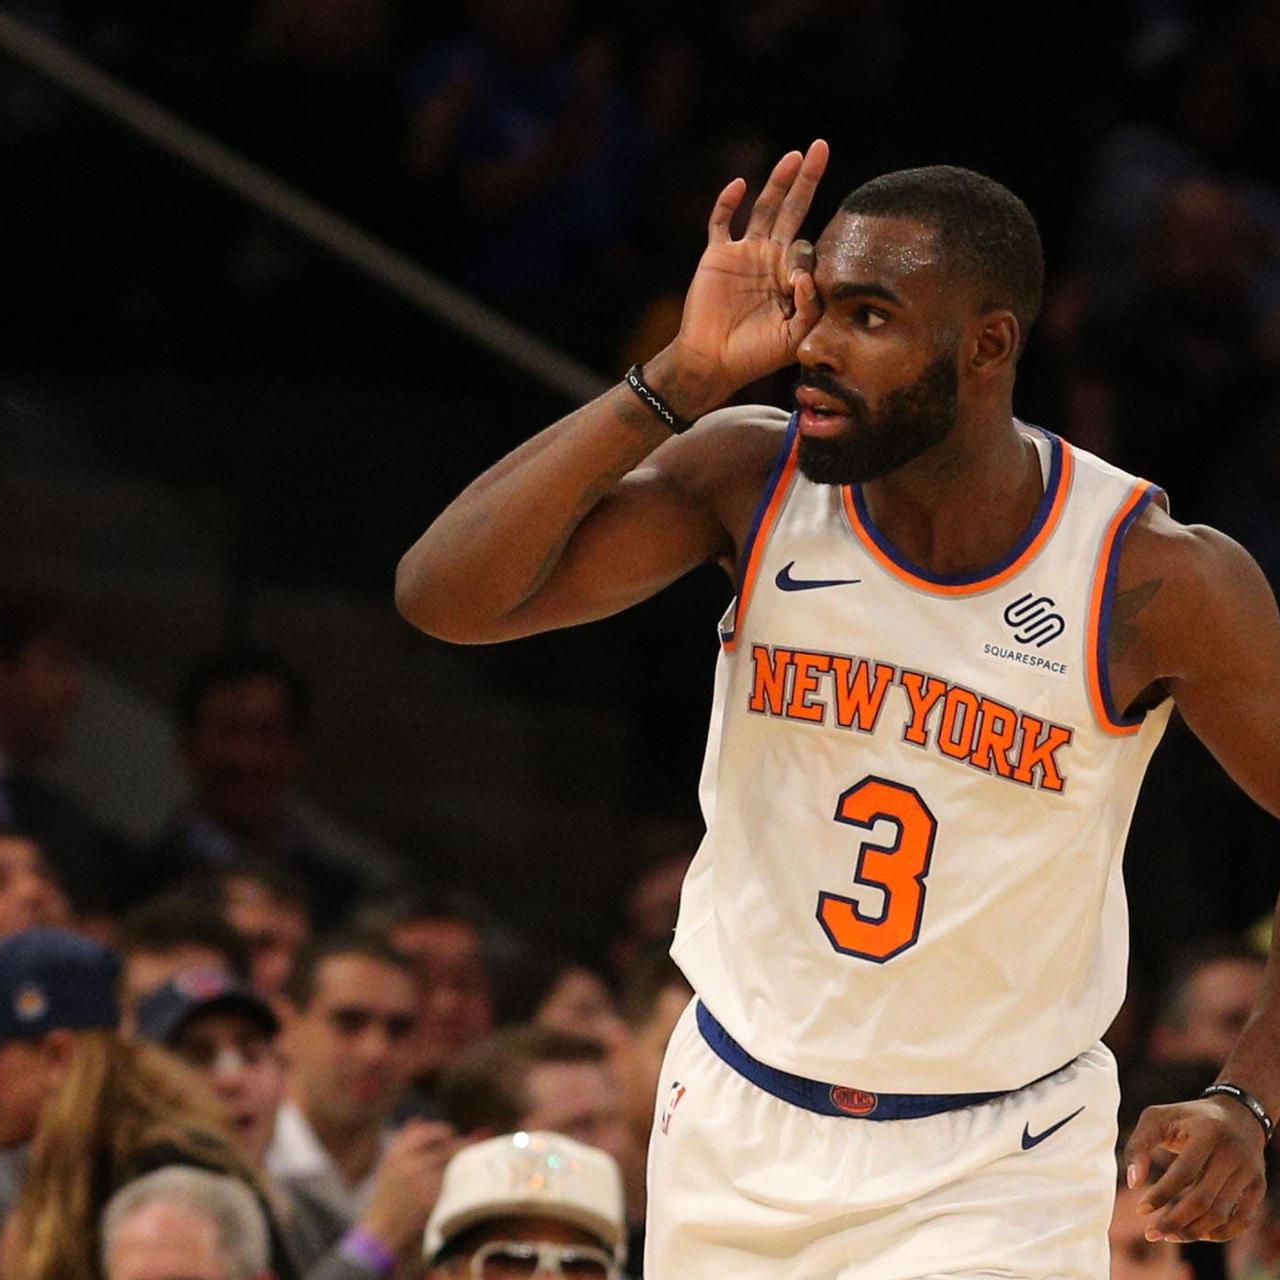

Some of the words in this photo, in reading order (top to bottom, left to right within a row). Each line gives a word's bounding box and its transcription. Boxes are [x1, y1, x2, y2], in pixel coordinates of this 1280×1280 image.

[748, 643, 897, 736] NEW
[900, 669, 1075, 795] YORK
[983, 642, 1068, 675] SQUARESPACE
[816, 774, 938, 965] 3
